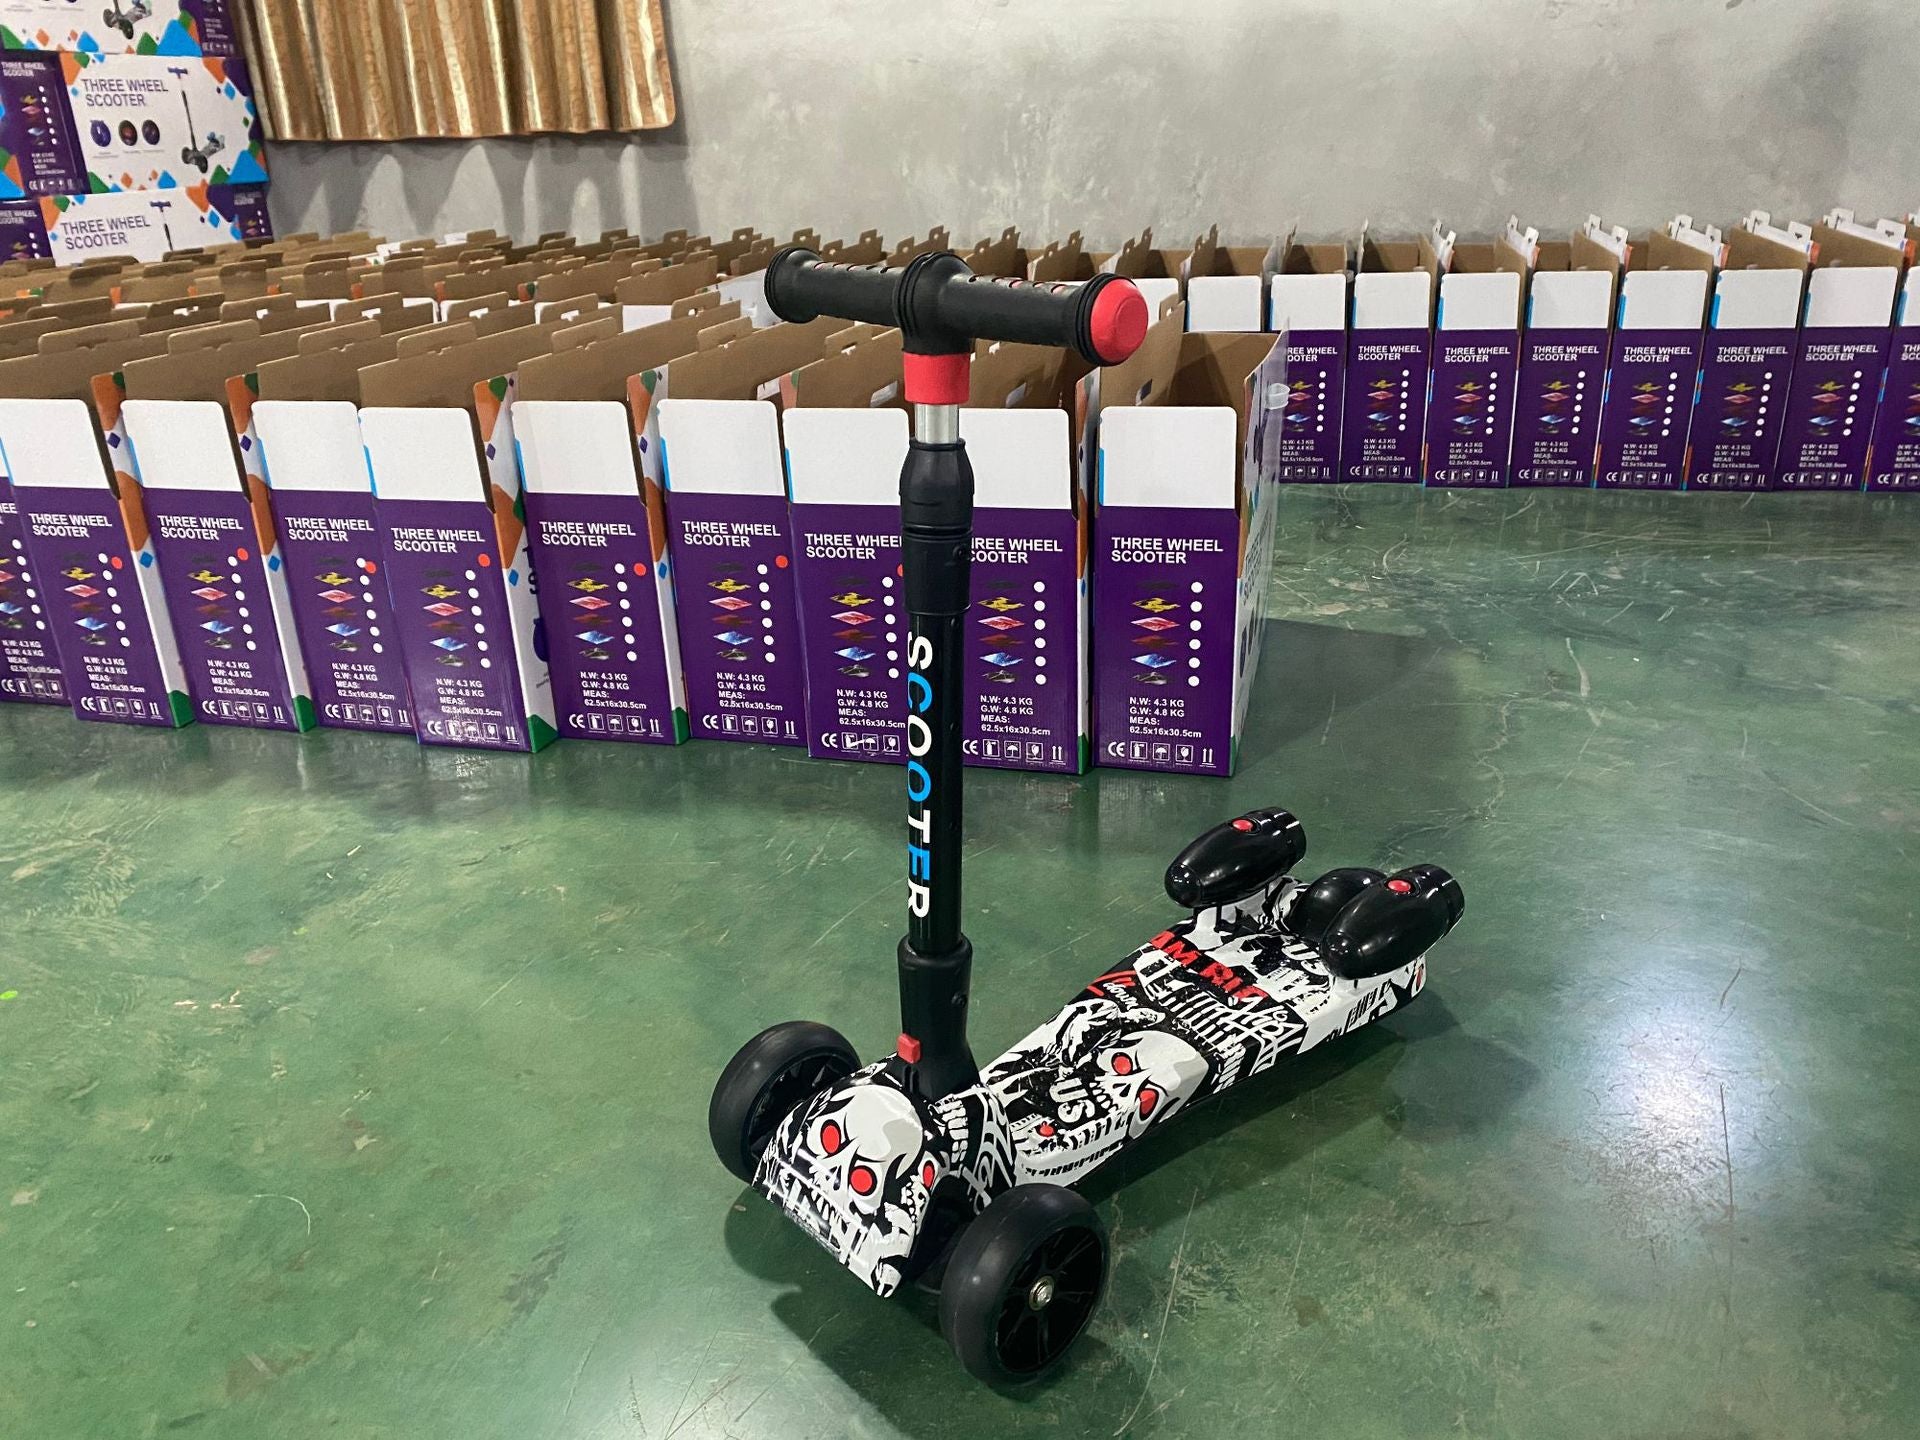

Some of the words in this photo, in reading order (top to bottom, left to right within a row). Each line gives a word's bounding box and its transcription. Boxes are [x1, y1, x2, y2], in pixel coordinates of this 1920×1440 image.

[81, 78, 125, 92] THREE
[125, 78, 169, 92] WHEEL
[85, 93, 147, 107] SCOOTER
[60, 219, 105, 235] THREE
[107, 215, 151, 230] WHEEL
[65, 231, 127, 250] SCOOTER
[1287, 347, 1305, 355] REE
[1306, 347, 1338, 355] WHEEL
[1358, 345, 1388, 353] THREE
[1390, 345, 1421, 353] WHEEL
[1445, 347, 1476, 355] THREE
[1477, 347, 1511, 355] WHEEL
[1533, 346, 1564, 354] THREE
[1566, 346, 1599, 354] WHEEL
[1624, 346, 1656, 355] THREE
[1658, 347, 1692, 355] WHEEL
[1718, 346, 1751, 355] THREE
[1753, 346, 1788, 355] WHEEL
[1808, 345, 1841, 353] THREE
[1843, 345, 1878, 353] WHEEL
[1287, 354, 1318, 362] OOTER
[1358, 352, 1401, 361] SCOOTER
[1444, 354, 1489, 363] SCOOTER
[1532, 352, 1577, 361] SCOOTER
[1623, 353, 1670, 362] SCOOTER
[1716, 354, 1764, 362] SCOOTER
[1805, 352, 1854, 361] SCOOTER
[1350, 466, 1360, 476] CE
[1435, 470, 1446, 480] CE
[1518, 469, 1530, 479] CE
[1606, 472, 1618, 482] CE
[1697, 473, 1709, 483] CE
[1782, 473, 1795, 483] CE
[28, 513, 69, 525] THREE
[68, 514, 113, 527] WHEEL
[157, 515, 199, 528] THREE
[199, 517, 244, 530] WHEEL
[285, 517, 327, 529] THREE
[328, 518, 374, 531] WHEEL
[32, 524, 90, 538] SCOOTER
[161, 527, 220, 540] SCOOTER
[539, 521, 585, 534] THREE
[587, 523, 636, 536] WHEEL
[682, 521, 728, 534] THREE
[730, 523, 781, 536] WHEEL
[288, 528, 349, 542] SCOOTER
[390, 527, 435, 540] THREE
[436, 529, 485, 542] WHEEL
[542, 533, 607, 547] SCOOTER
[684, 533, 751, 547] SCOOTER
[804, 533, 853, 546] THREE
[394, 540, 458, 553] SCOOTER
[970, 537, 1005, 552] REE
[1008, 538, 1063, 552] WHEEL
[1111, 537, 1163, 550] THREE
[1167, 538, 1224, 552] WHEEL
[806, 546, 876, 559] SCOOTER
[970, 549, 1028, 564] OOTER
[1111, 550, 1186, 564] SCOOTER
[601, 672, 613, 680] 4.3
[614, 673, 628, 681] KG
[737, 673, 750, 681] 4.3
[751, 674, 765, 682] KG
[469, 680, 483, 688] KG
[602, 681, 615, 689] 4.8
[616, 682, 630, 690] KG
[739, 683, 751, 691] 4.8
[753, 683, 766, 692] KG
[471, 689, 485, 697] KG
[583, 690, 609, 698] MEAS:
[718, 690, 745, 699] MEAS:
[837, 689, 857, 697] N.W:
[859, 690, 872, 698] 4.3
[873, 691, 888, 699] KG
[81, 697, 96, 711] CE
[584, 699, 647, 709] 62.5x16x30.5cm
[719, 699, 783, 711] 62.5x16x30.5cm
[837, 698, 858, 707] G.W:
[860, 700, 873, 708] 4.8
[874, 700, 889, 709] KG
[980, 695, 1001, 704] N.W:
[1003, 696, 1017, 705] 4.3
[1018, 697, 1033, 706] KG
[1129, 697, 1151, 705] N.W:
[1153, 698, 1167, 706] 4.3
[1170, 699, 1184, 708] KG
[202, 700, 218, 715] CE
[325, 703, 340, 718] CE
[838, 708, 867, 717] MEAS:
[980, 704, 1002, 713] G.W:
[1004, 706, 1017, 714] 4.8
[1019, 707, 1033, 715] KG
[1129, 706, 1152, 715] G.W:
[1154, 708, 1168, 716] 4.8
[1170, 709, 1185, 717] KG
[569, 714, 586, 729] CE
[702, 714, 719, 729] CE
[839, 717, 906, 728] 62.5x16x30.5cm
[981, 714, 1010, 723] MEAS:
[1129, 716, 1160, 725] MEAS:
[425, 720, 444, 736] CE
[981, 724, 1051, 736] 62.5x16x30.5cm
[1129, 726, 1202, 738] 62.5x16x30.5cm
[821, 733, 838, 748] CE
[962, 739, 978, 755] CE
[1108, 741, 1126, 757] CE
[907, 631, 933, 918] SCOOTER
[1049, 1077, 1096, 1123] US
